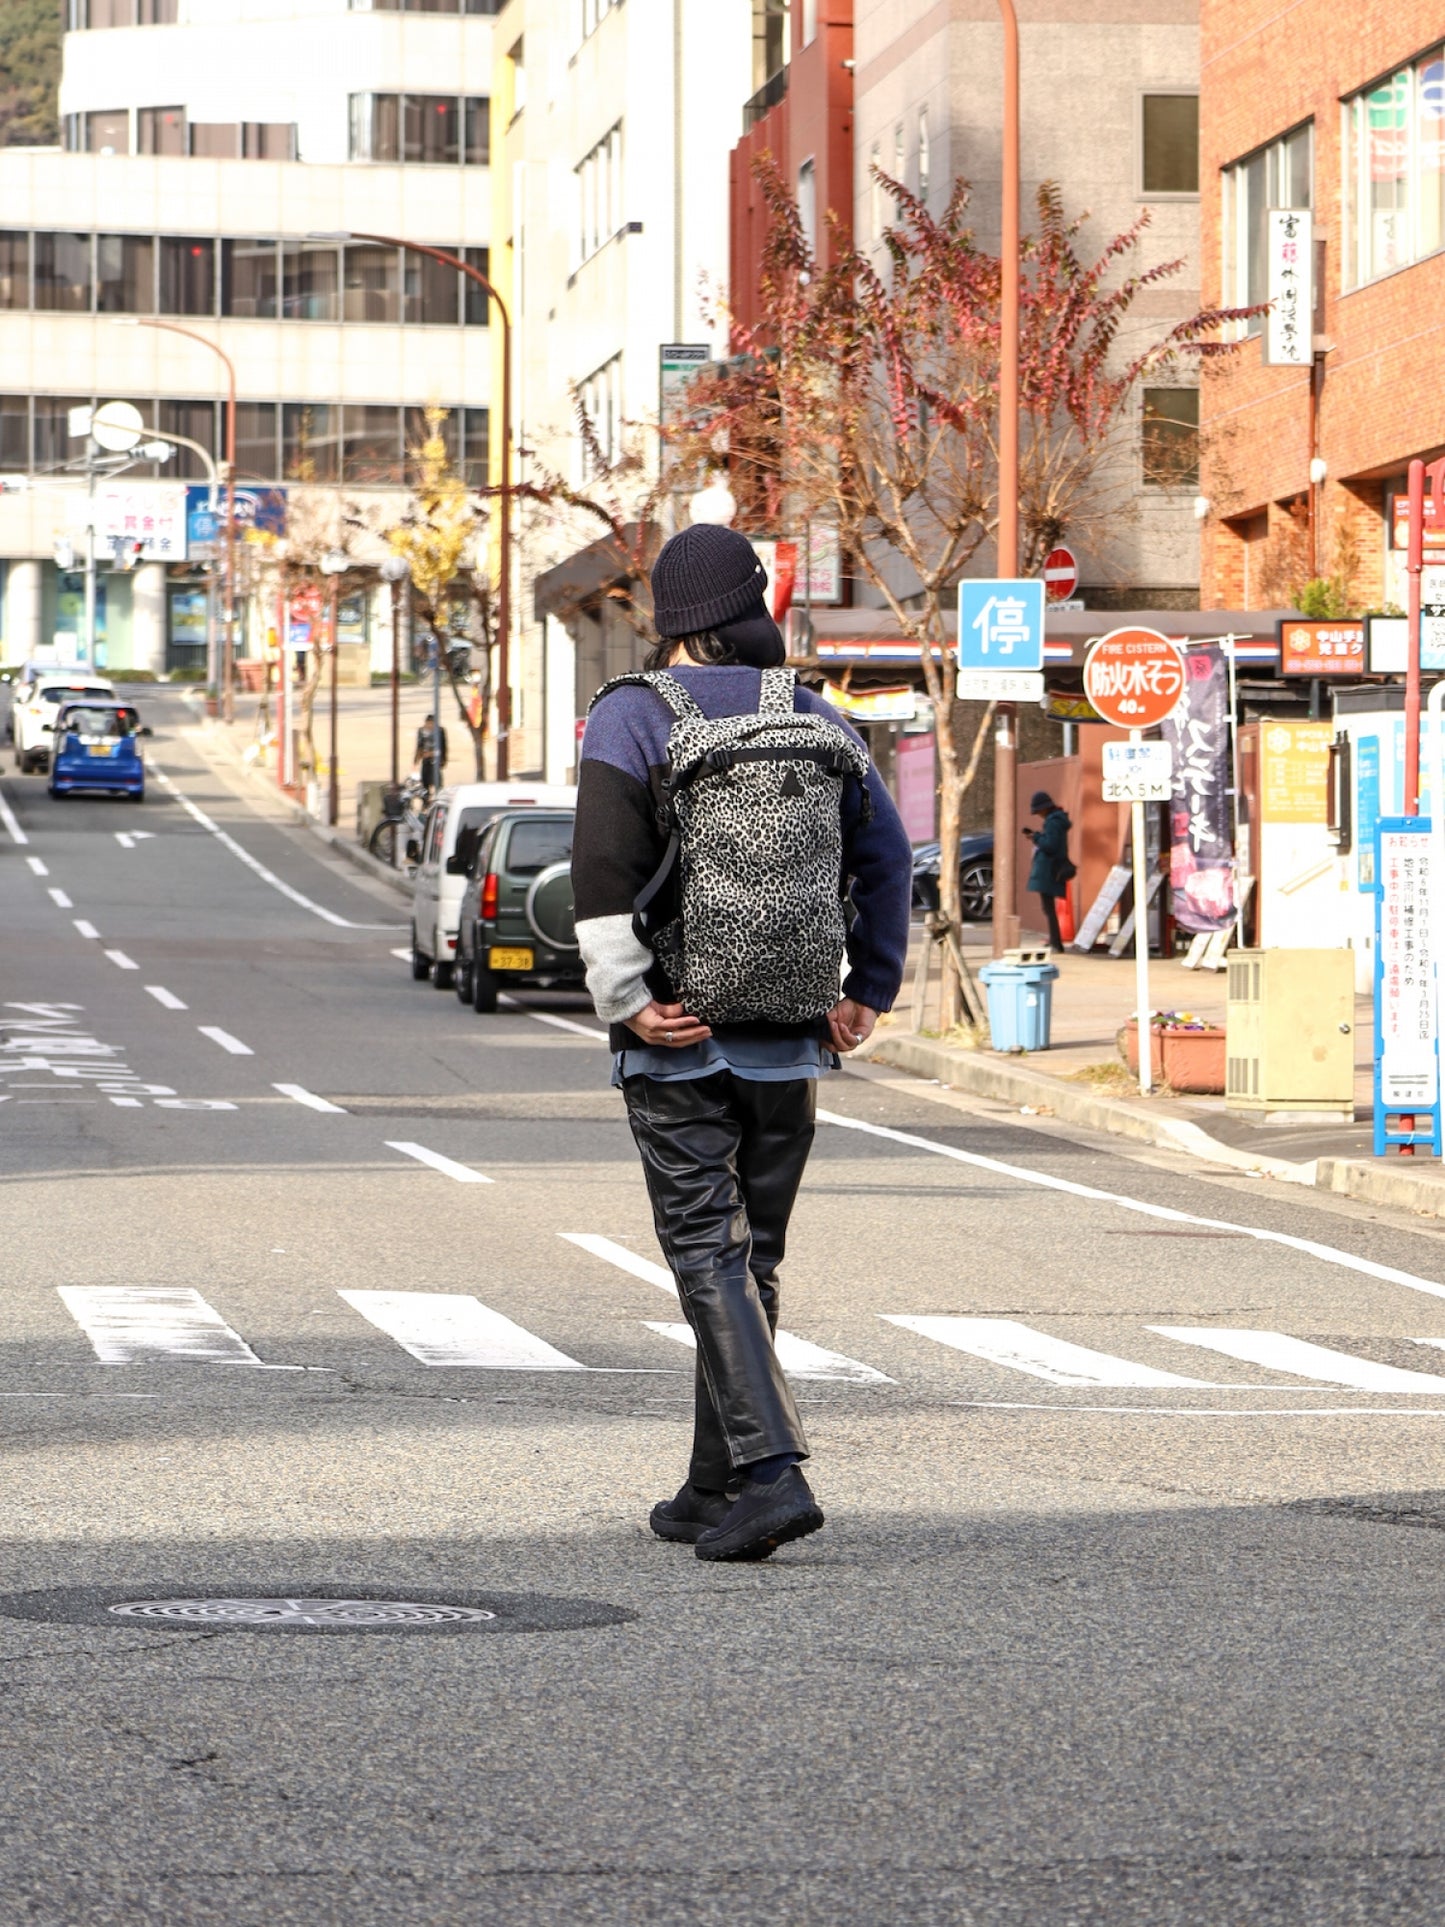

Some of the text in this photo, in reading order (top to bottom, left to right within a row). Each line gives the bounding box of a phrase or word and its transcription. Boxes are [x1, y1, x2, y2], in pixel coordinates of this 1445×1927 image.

[972, 595, 1030, 655] 停
[1102, 643, 1167, 655] FIRE CISTERN
[1091, 659, 1181, 697] 防火水そう
[1185, 718, 1217, 853] ステーキ
[1389, 836, 1429, 848] お知らせ
